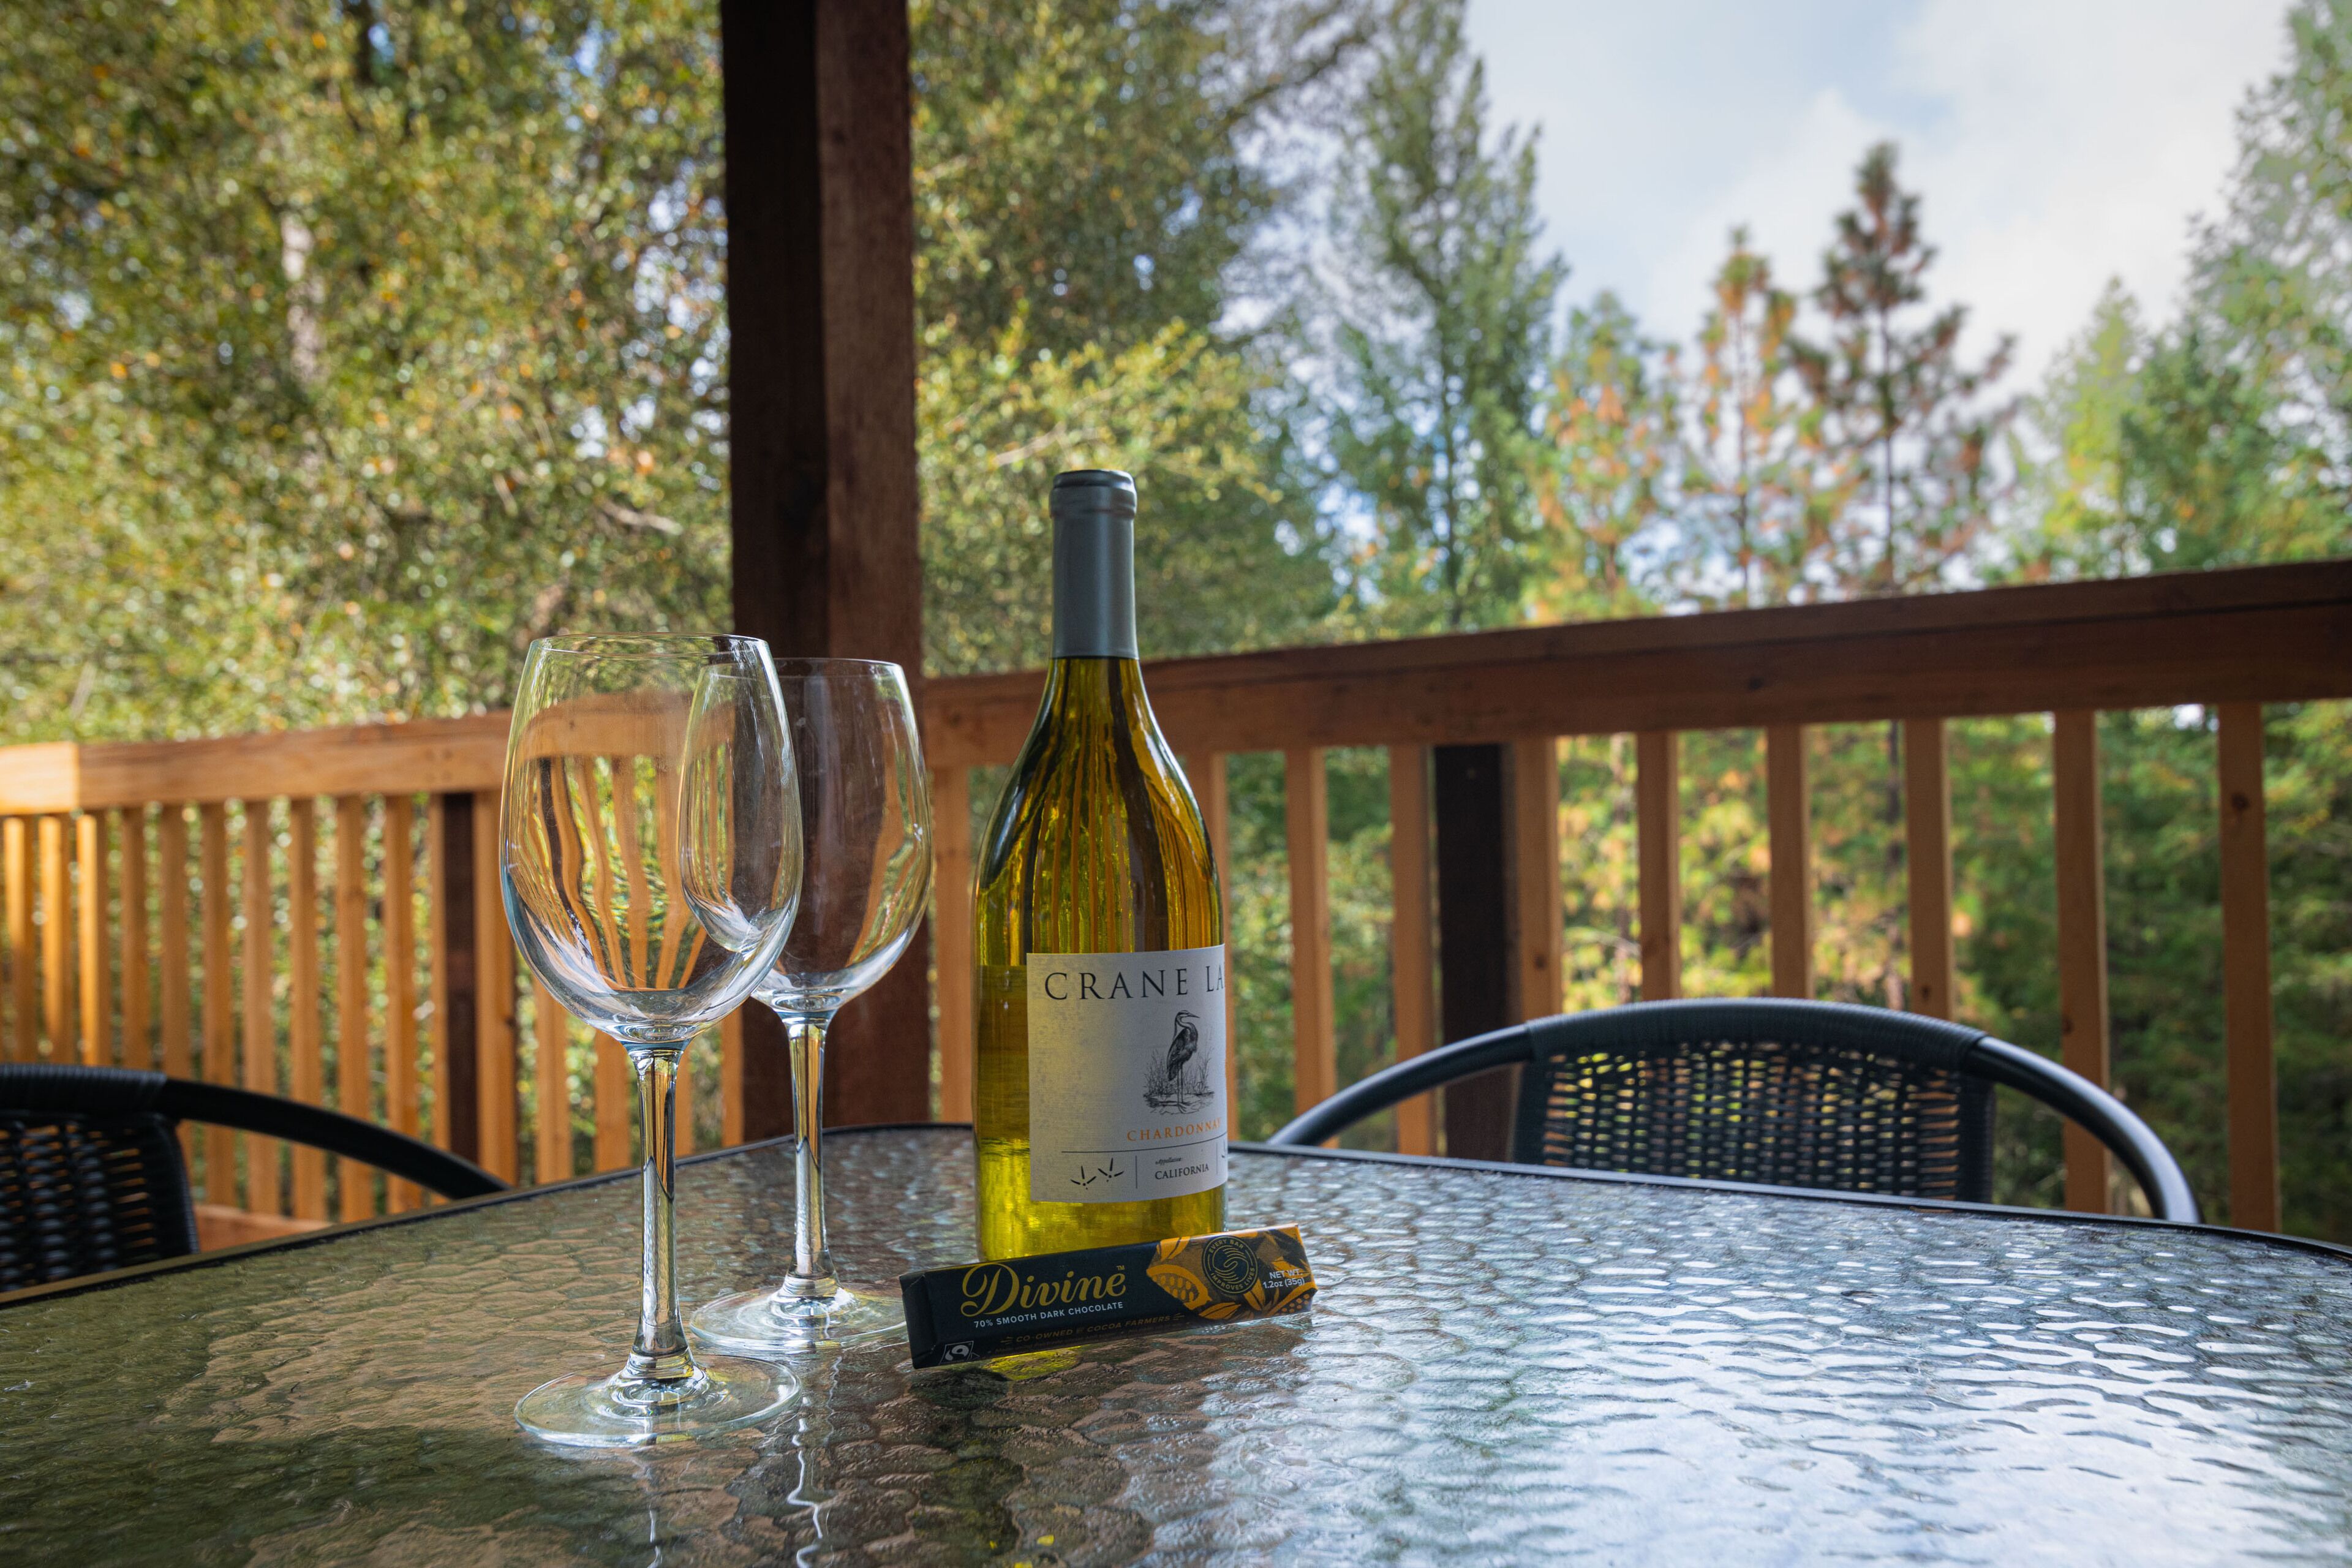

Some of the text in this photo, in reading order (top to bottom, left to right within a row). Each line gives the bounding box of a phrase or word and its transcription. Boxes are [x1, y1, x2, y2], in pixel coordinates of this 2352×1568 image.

[1044, 968, 1188, 1000] CRANE
[1155, 1163, 1210, 1180] CALIFORNIA
[1208, 1239, 1244, 1253] EVERY BAR
[1210, 1267, 1256, 1290] IMPROVES LIVES
[1269, 1270, 1285, 1280] NET
[1284, 1277, 1305, 1287] (35g)
[960, 1262, 1126, 1317] Divine
[974, 1302, 1124, 1329] 70% SMOOTH DARK CHOCOLATE
[1016, 1329, 1072, 1343] CO-OWNED
[1087, 1322, 1122, 1333] COCOA
[1125, 1315, 1171, 1327] FARMERS
